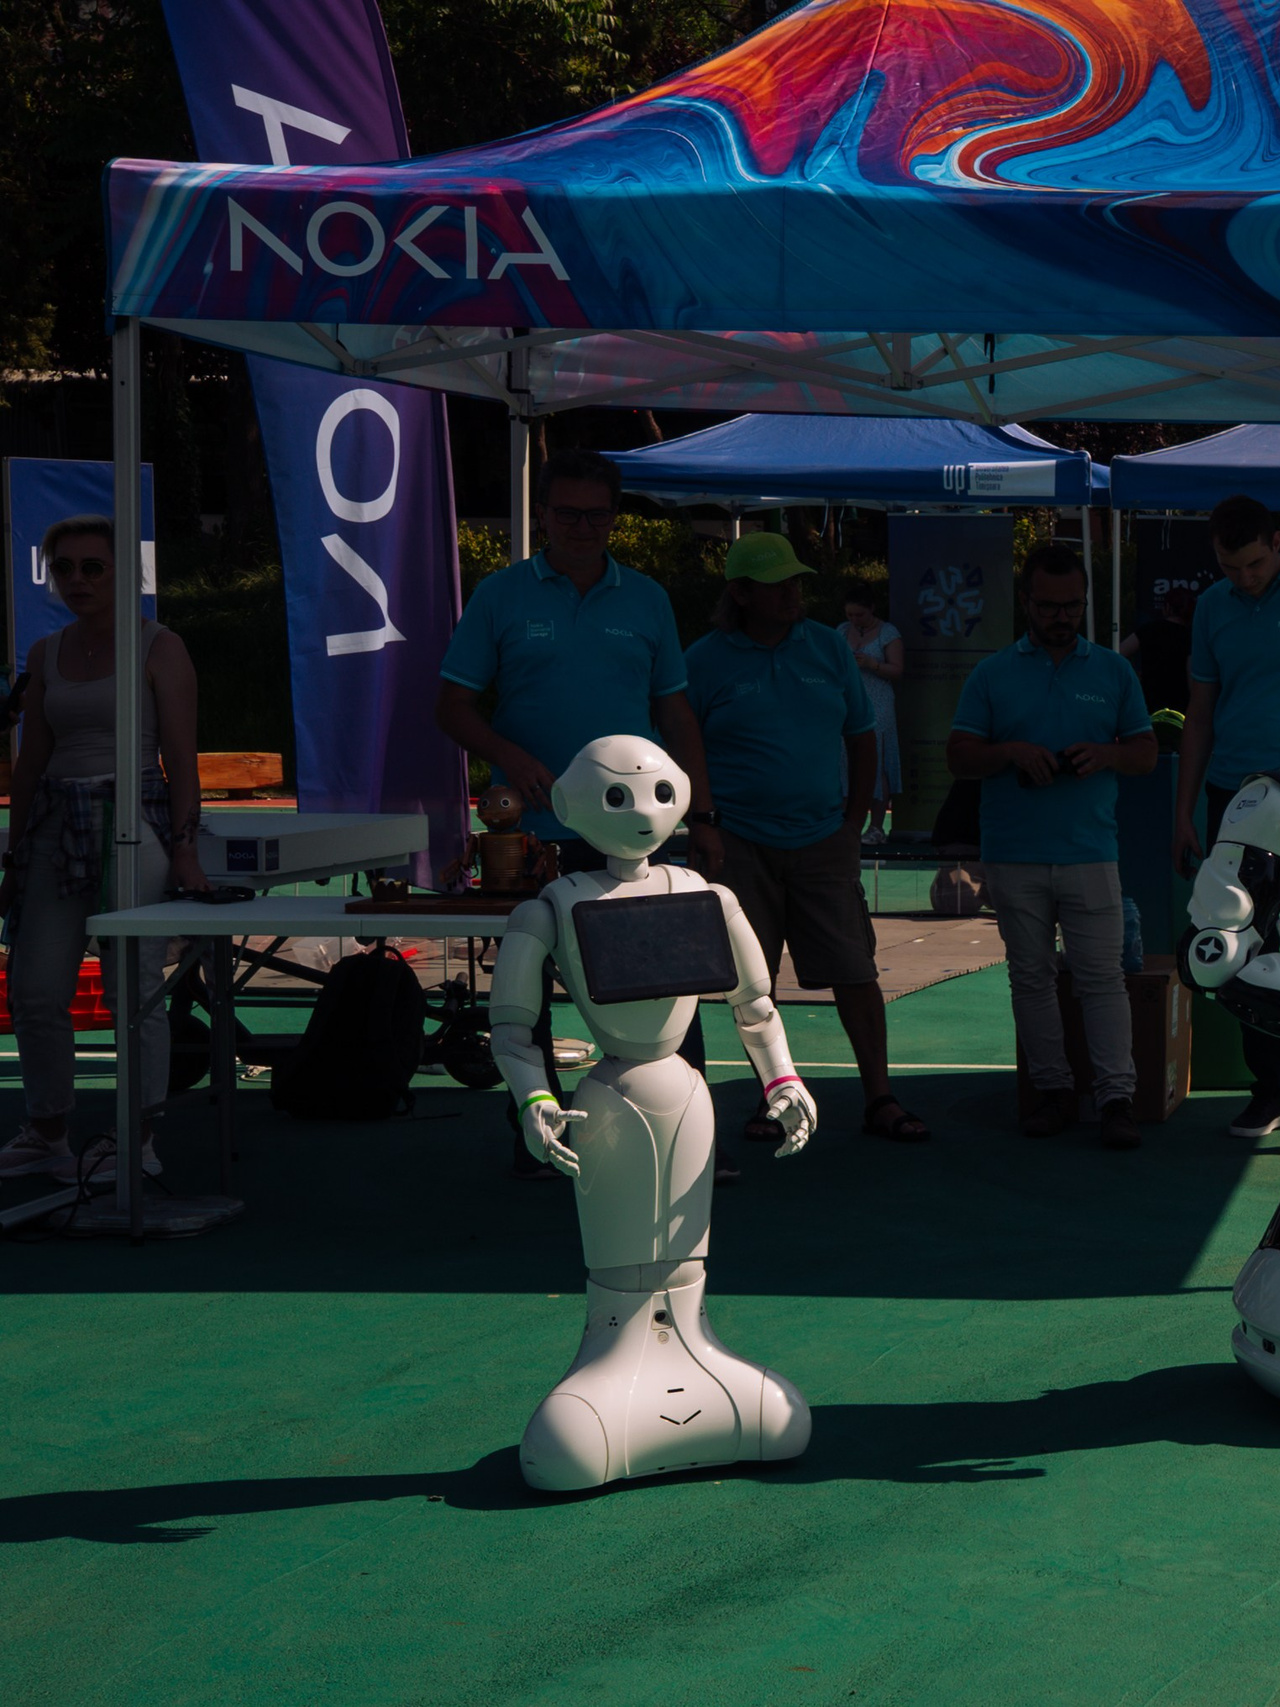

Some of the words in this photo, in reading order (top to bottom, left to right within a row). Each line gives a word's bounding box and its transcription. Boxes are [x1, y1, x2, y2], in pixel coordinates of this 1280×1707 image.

[227, 196, 572, 281] NOKIA
[605, 627, 634, 638] NOKIA
[1075, 692, 1106, 705] NOKIA
[228, 851, 257, 860] NOKIA
